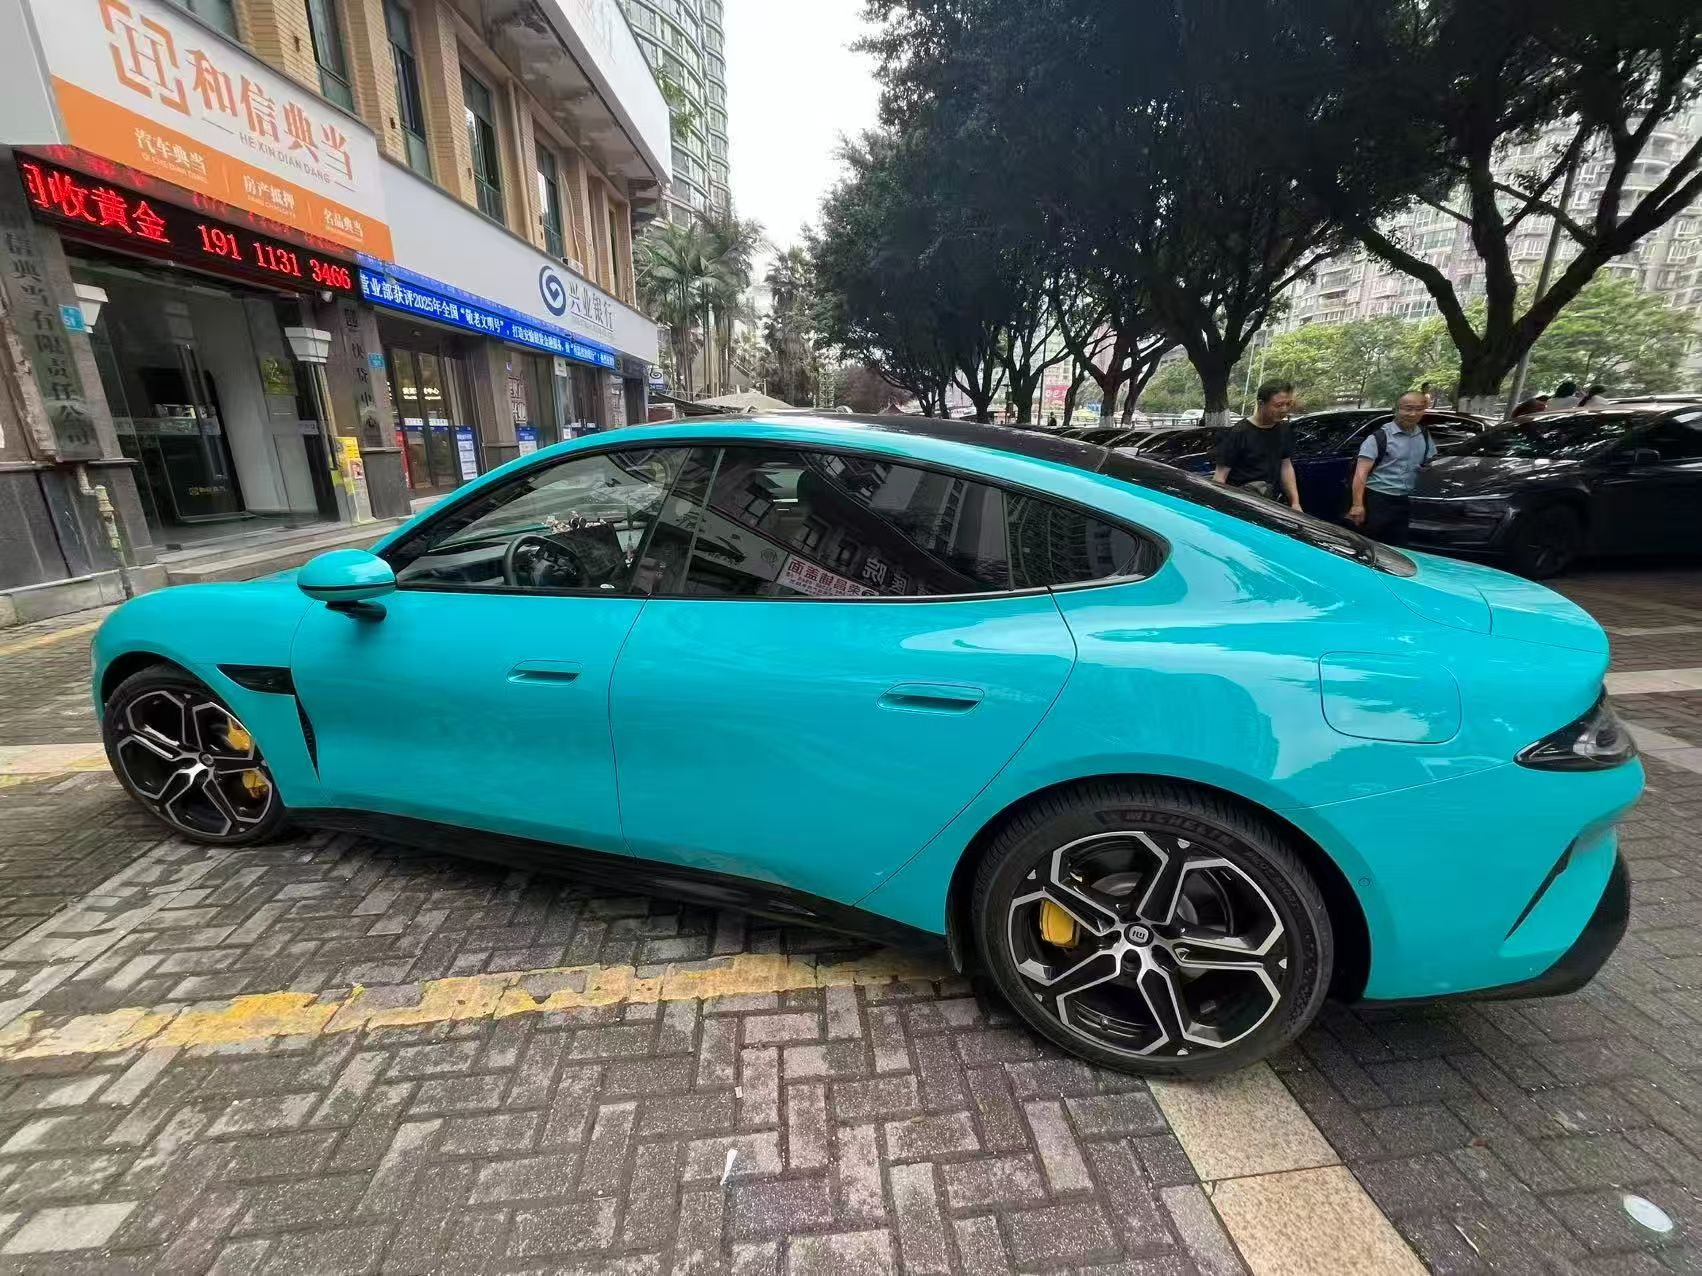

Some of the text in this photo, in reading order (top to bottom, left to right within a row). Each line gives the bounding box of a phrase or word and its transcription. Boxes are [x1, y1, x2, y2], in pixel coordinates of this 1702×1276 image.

[184, 49, 353, 181] 和信典当
[135, 128, 207, 175] 汽车典当
[278, 151, 302, 169] DIAN
[304, 163, 331, 184] DANG
[243, 175, 295, 210] 房产抵押
[323, 207, 363, 238] 名品典当
[198, 224, 242, 260] 191
[254, 242, 302, 276] 1131
[310, 258, 352, 289] 3466
[569, 280, 614, 331] 兴业银行
